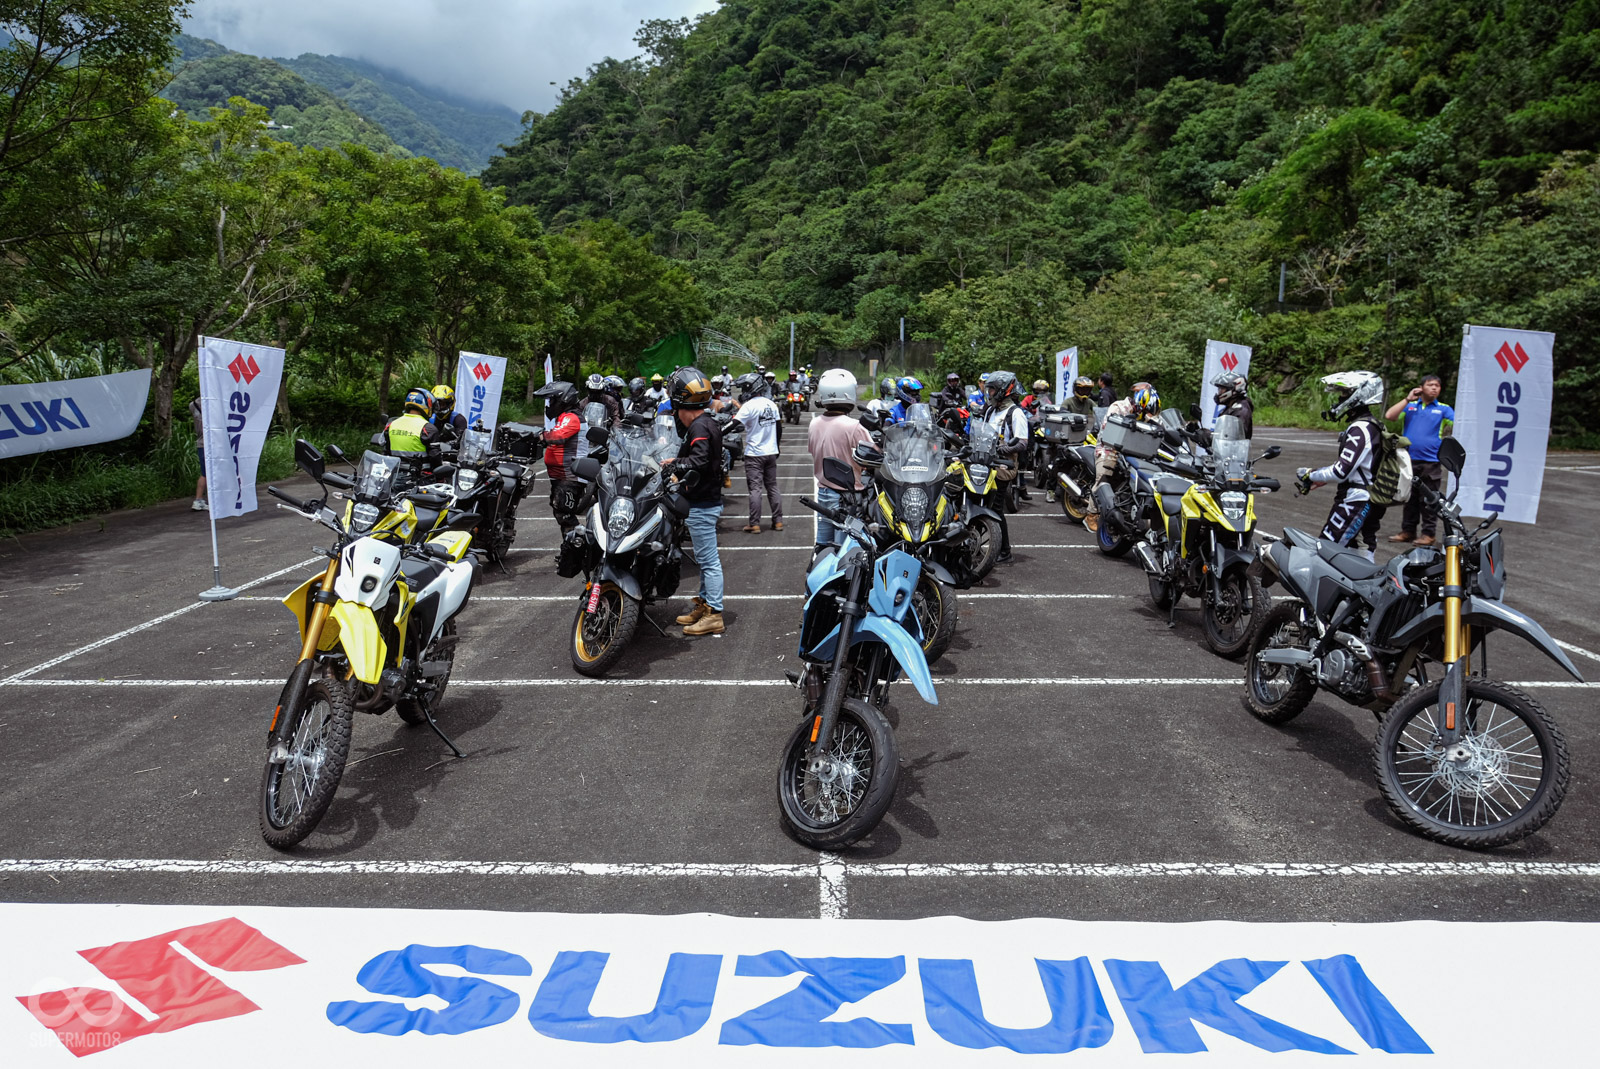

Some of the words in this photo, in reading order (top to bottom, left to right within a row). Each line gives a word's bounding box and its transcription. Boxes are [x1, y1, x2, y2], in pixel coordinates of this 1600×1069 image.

[1334, 433, 1361, 477] FOX
[1322, 502, 1355, 542] FOX
[326, 943, 1435, 1056] SUZUKI
